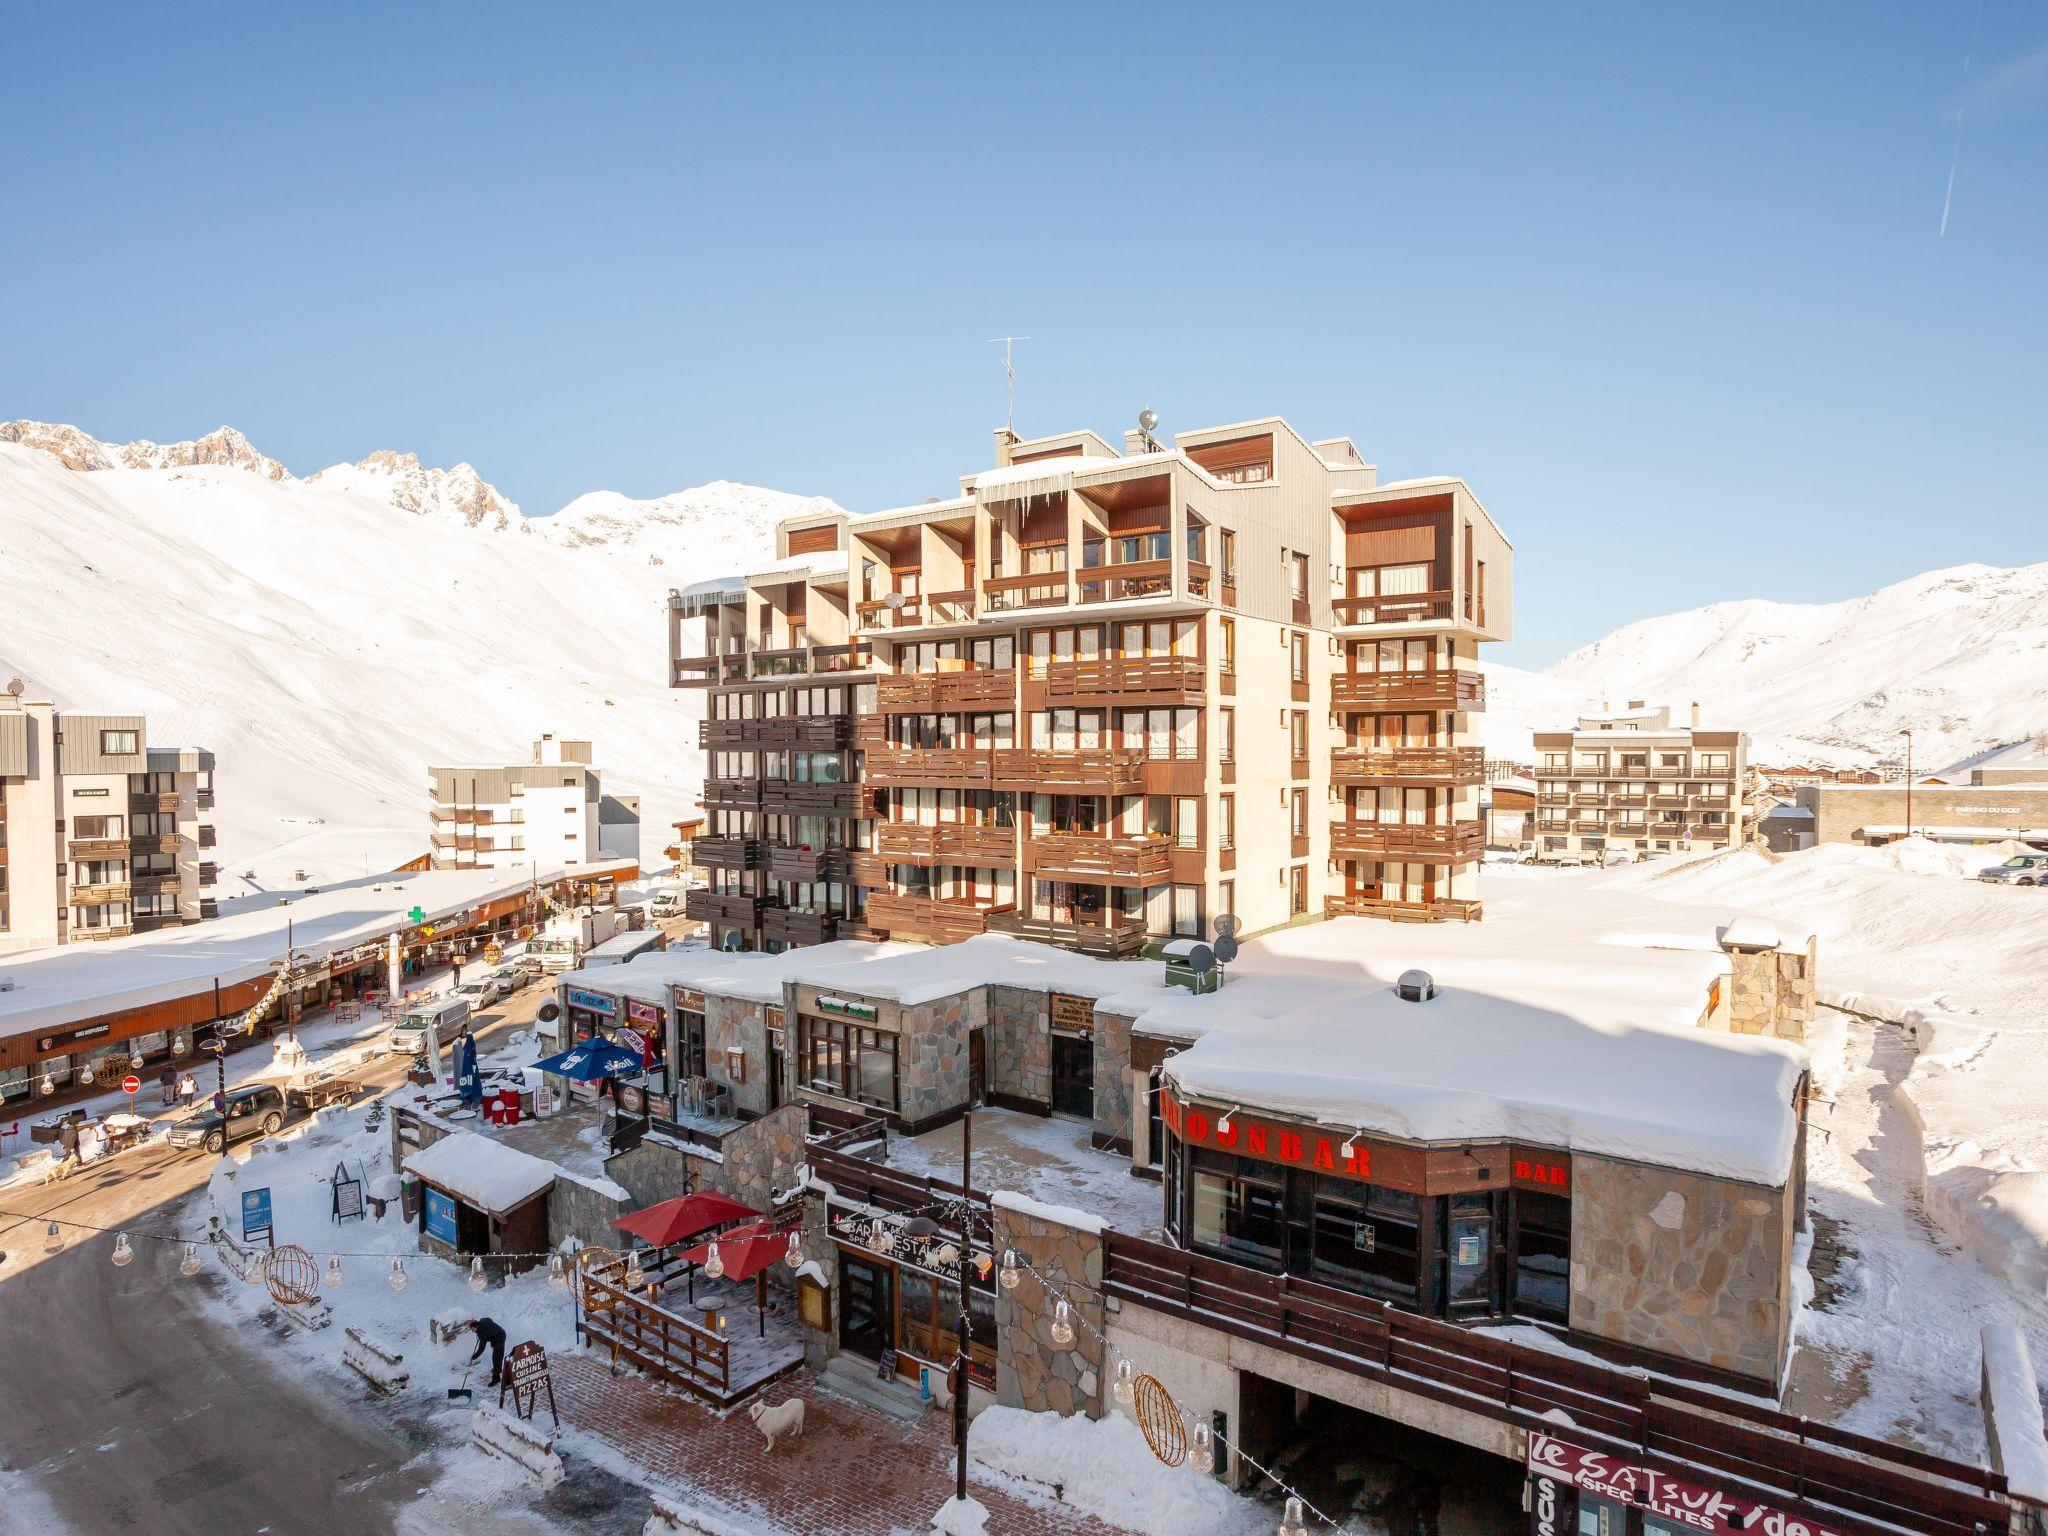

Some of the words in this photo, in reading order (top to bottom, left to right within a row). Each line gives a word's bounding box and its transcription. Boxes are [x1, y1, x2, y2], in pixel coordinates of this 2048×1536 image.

[1515, 1160, 1566, 1186] BAR
[515, 1362, 542, 1379] CUISINE
[518, 1376, 549, 1397] PIZZAS
